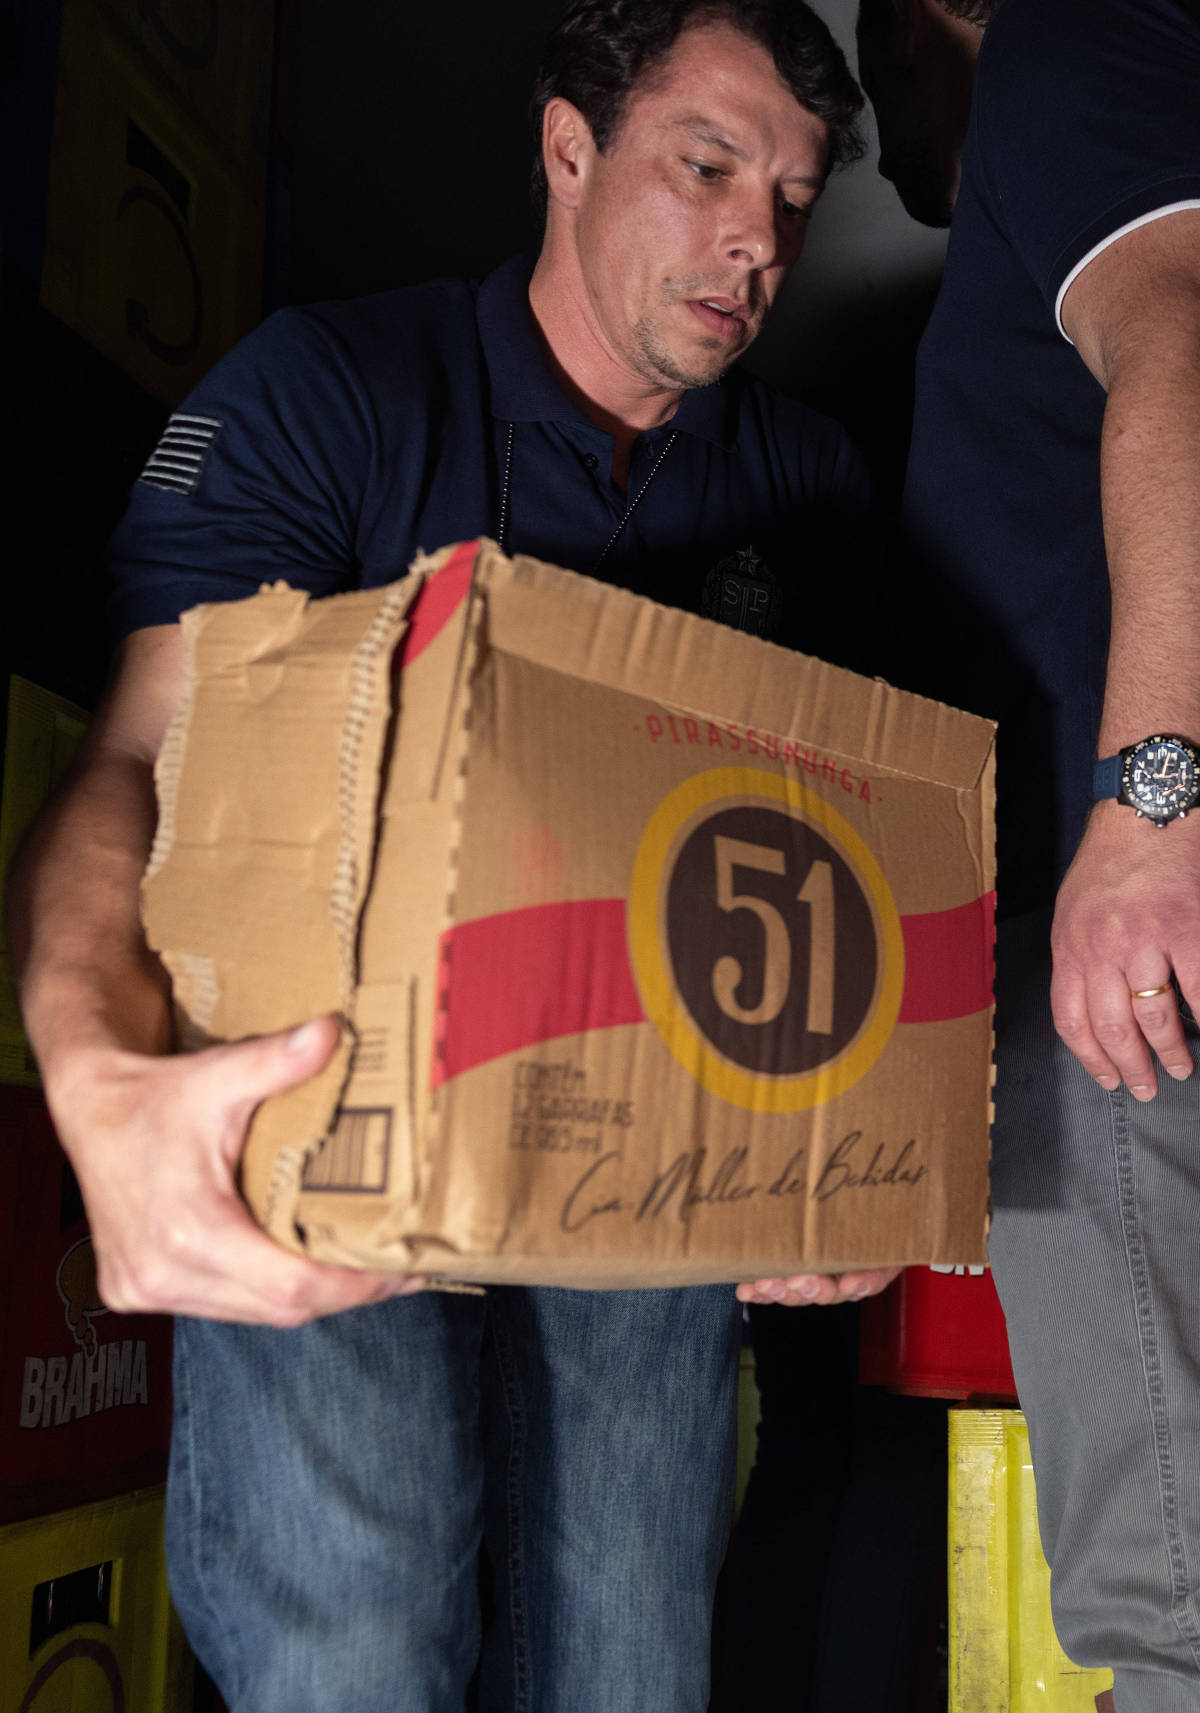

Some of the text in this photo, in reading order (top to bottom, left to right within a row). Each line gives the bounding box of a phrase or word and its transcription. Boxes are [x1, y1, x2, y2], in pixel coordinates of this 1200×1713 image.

[645, 714, 872, 804] PIRASSUNUNGA
[712, 834, 836, 1037] 51
[19, 1339, 149, 1430] BRAHMA
